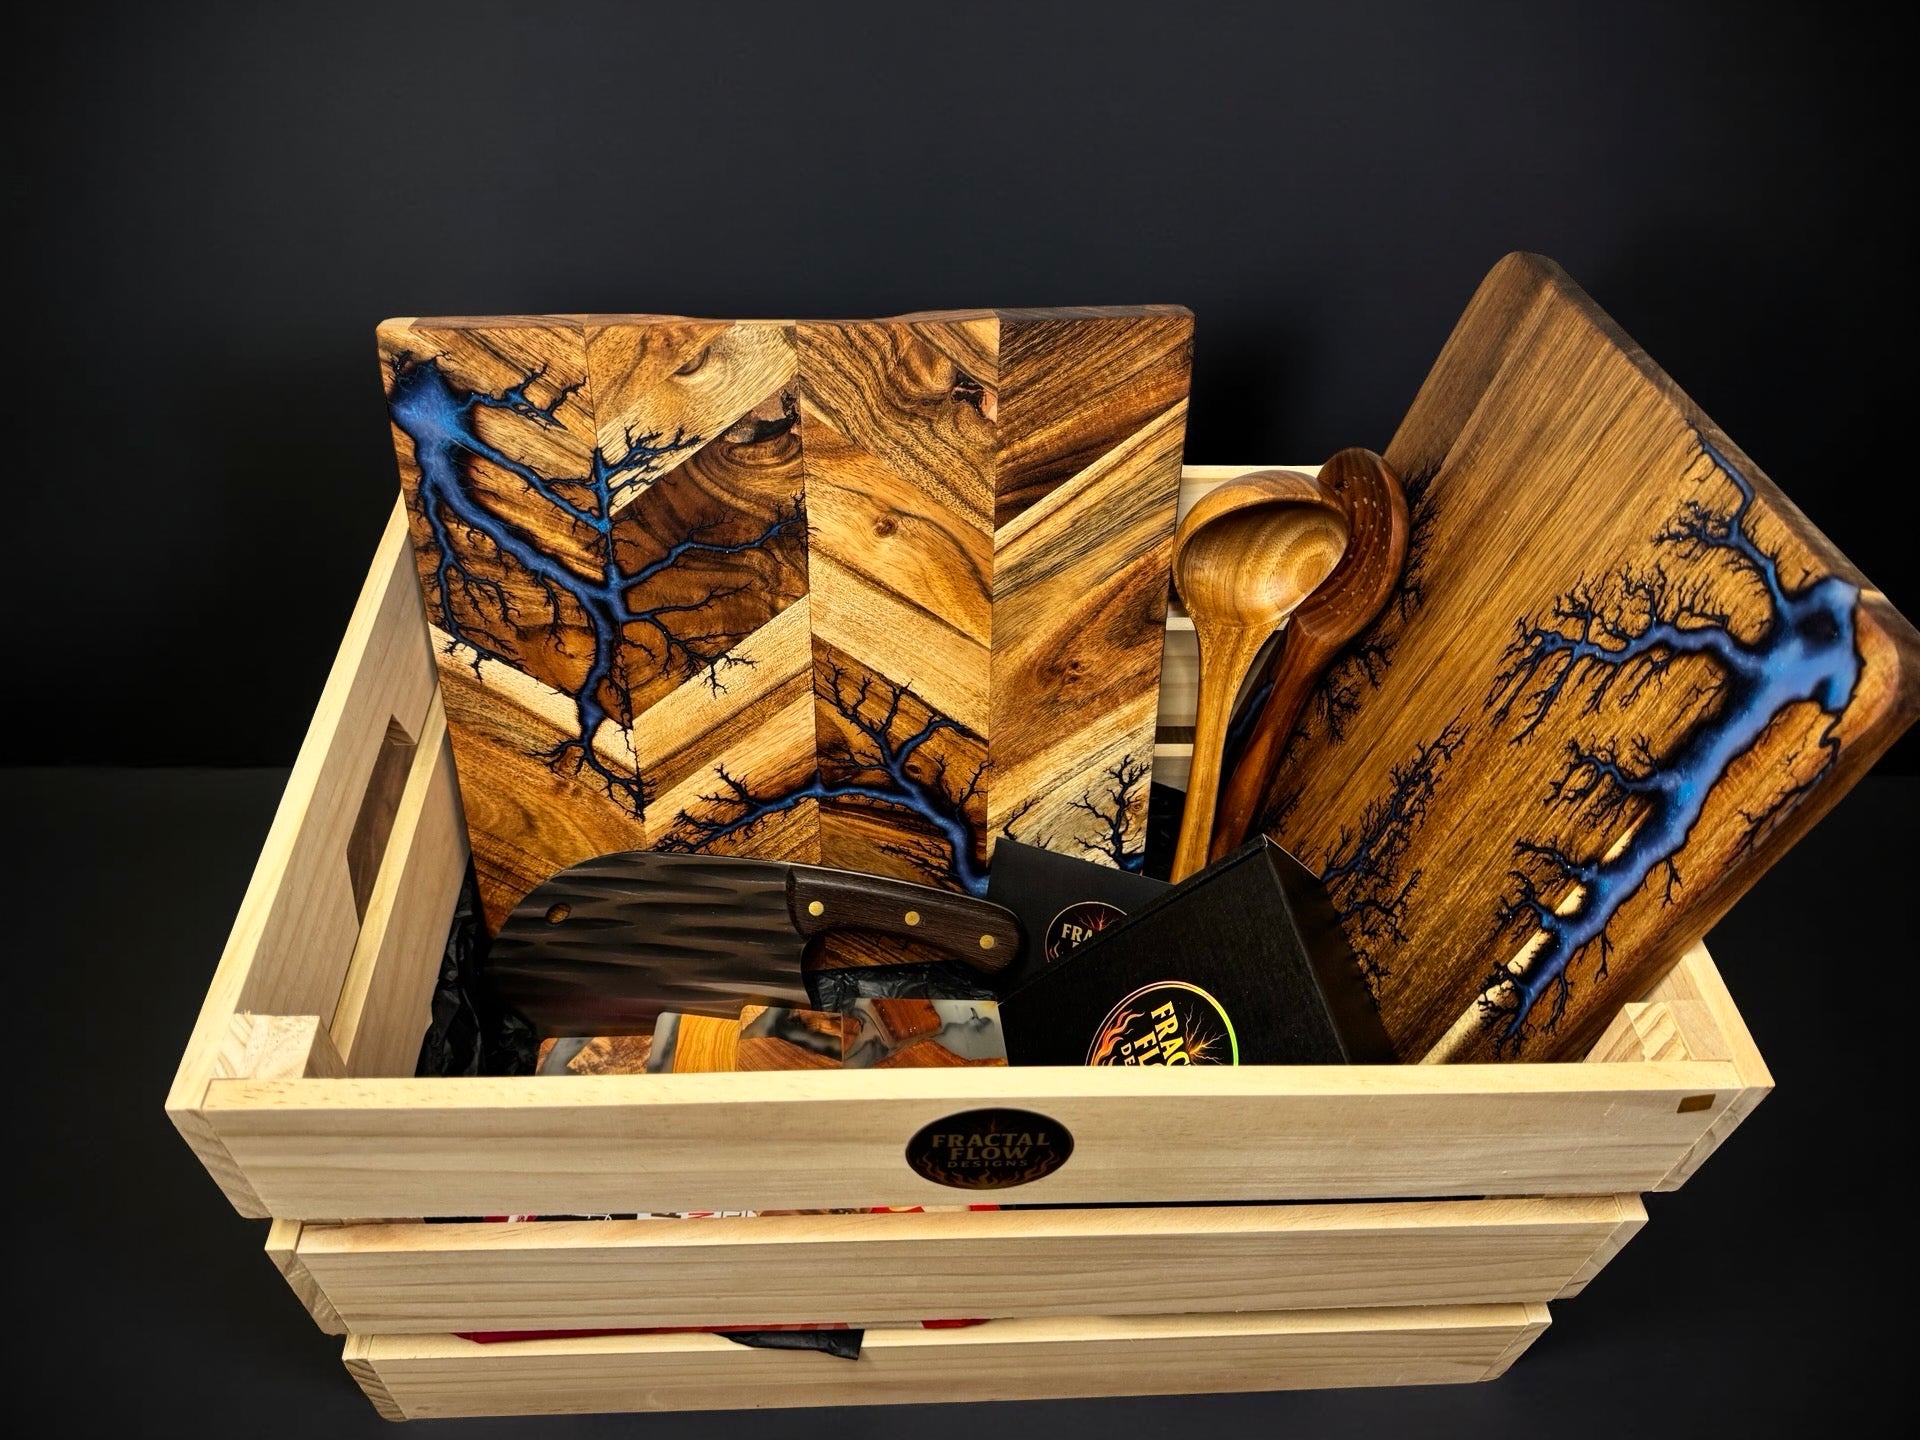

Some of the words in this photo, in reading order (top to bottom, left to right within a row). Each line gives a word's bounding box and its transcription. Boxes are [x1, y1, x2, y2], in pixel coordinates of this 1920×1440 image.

[1134, 1031, 1166, 1066] FL
[932, 1133, 1050, 1148] FRACTAL
[951, 1147, 1029, 1160] FLOW
[948, 1159, 1028, 1168] DESIGNS
